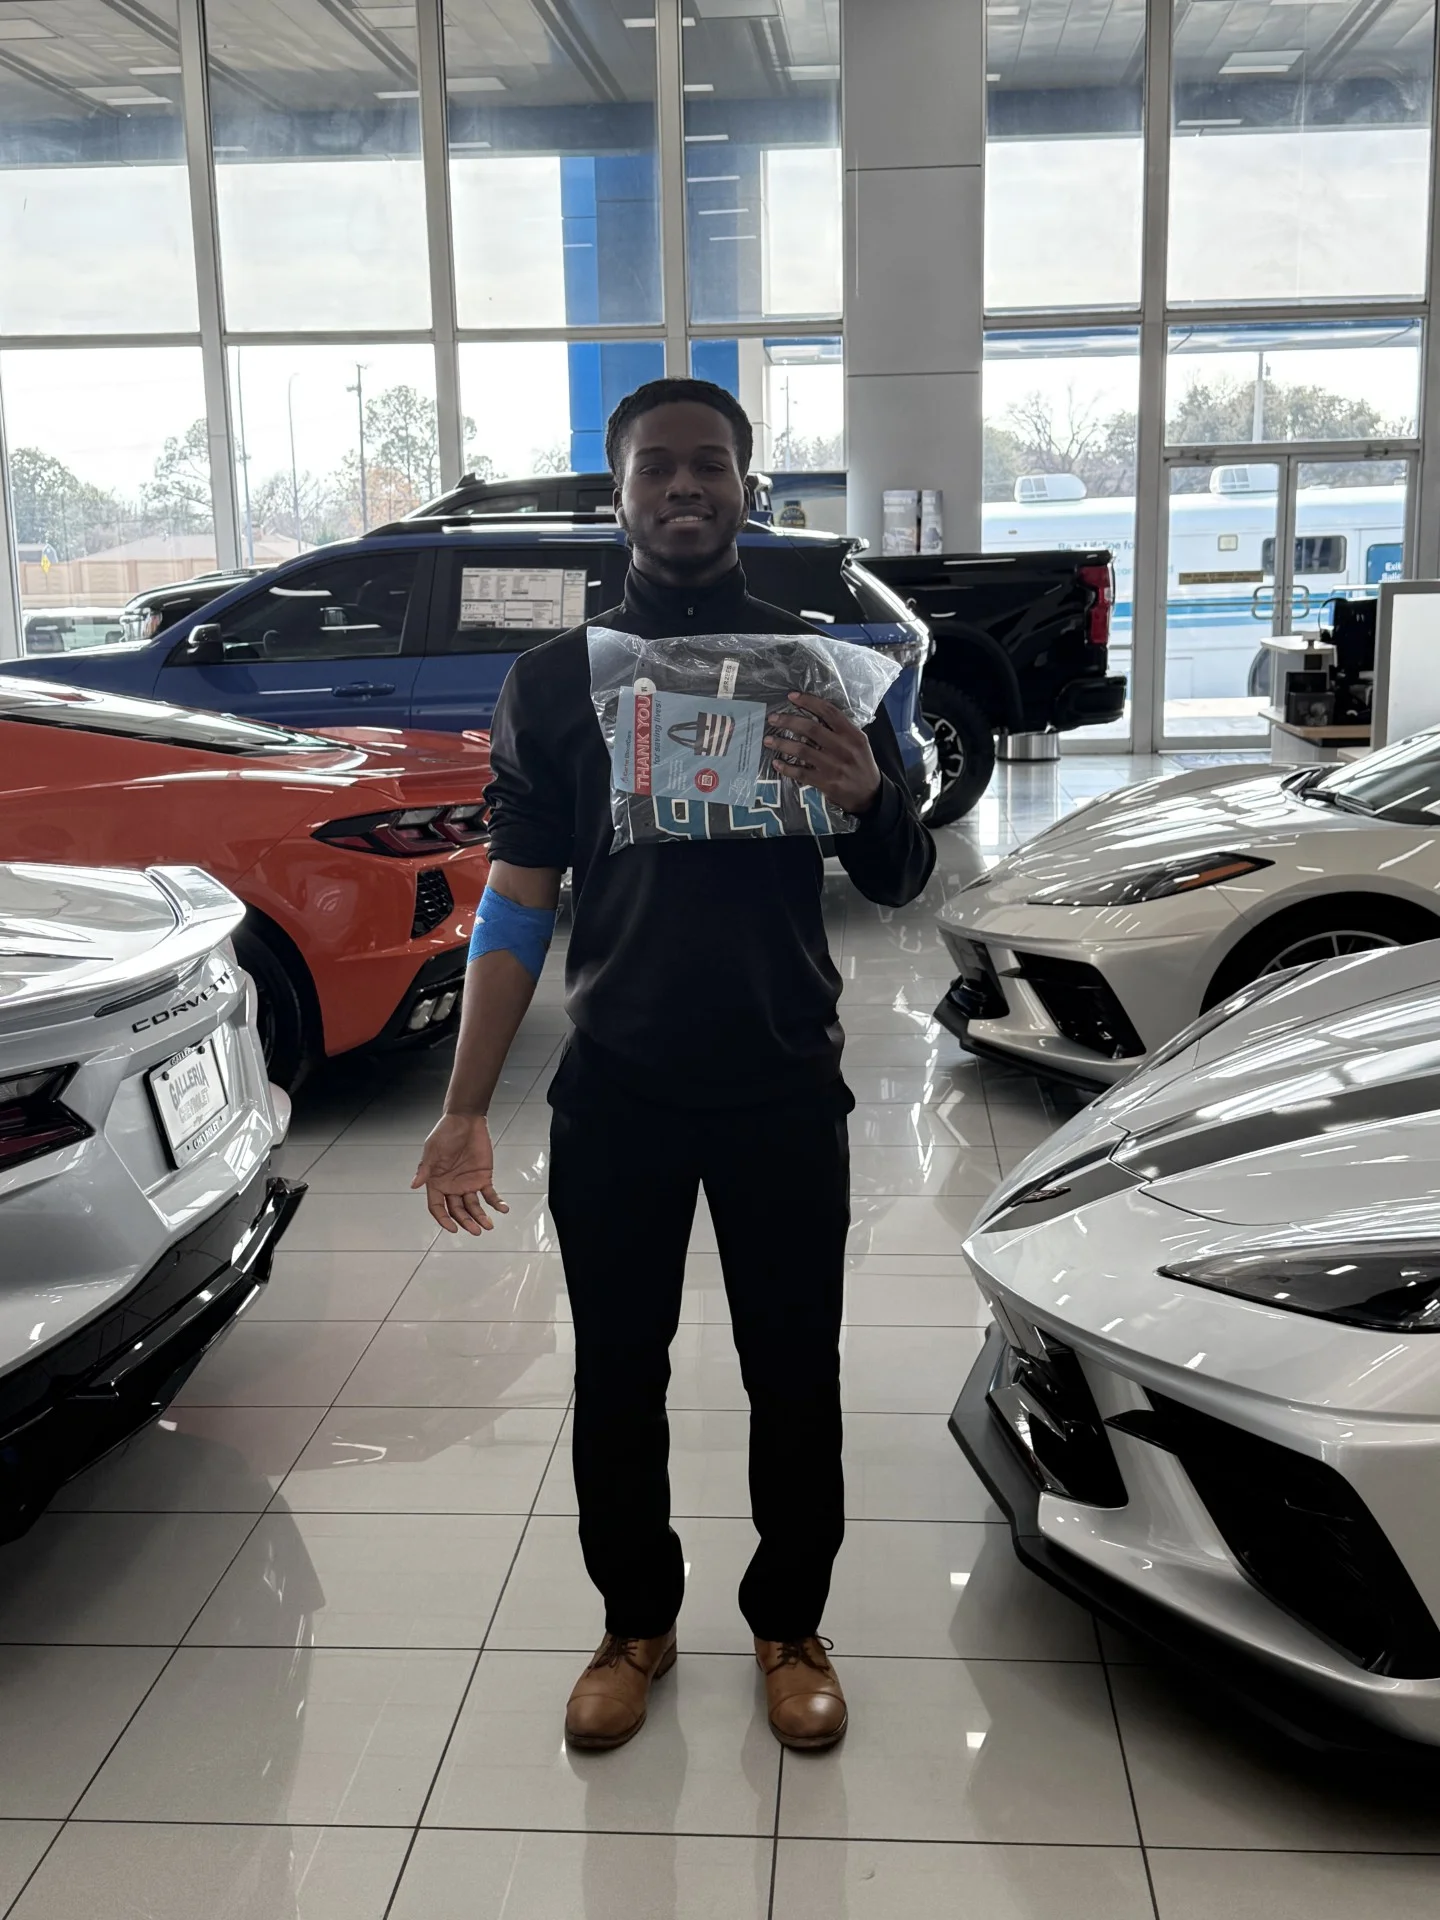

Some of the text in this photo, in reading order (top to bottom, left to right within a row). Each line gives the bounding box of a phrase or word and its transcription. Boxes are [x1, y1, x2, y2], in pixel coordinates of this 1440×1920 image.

[637, 695, 651, 729] YOU
[653, 699, 662, 765] for saving lives!
[636, 731, 651, 789] THANK
[169, 1061, 211, 1111] GALLERIA
